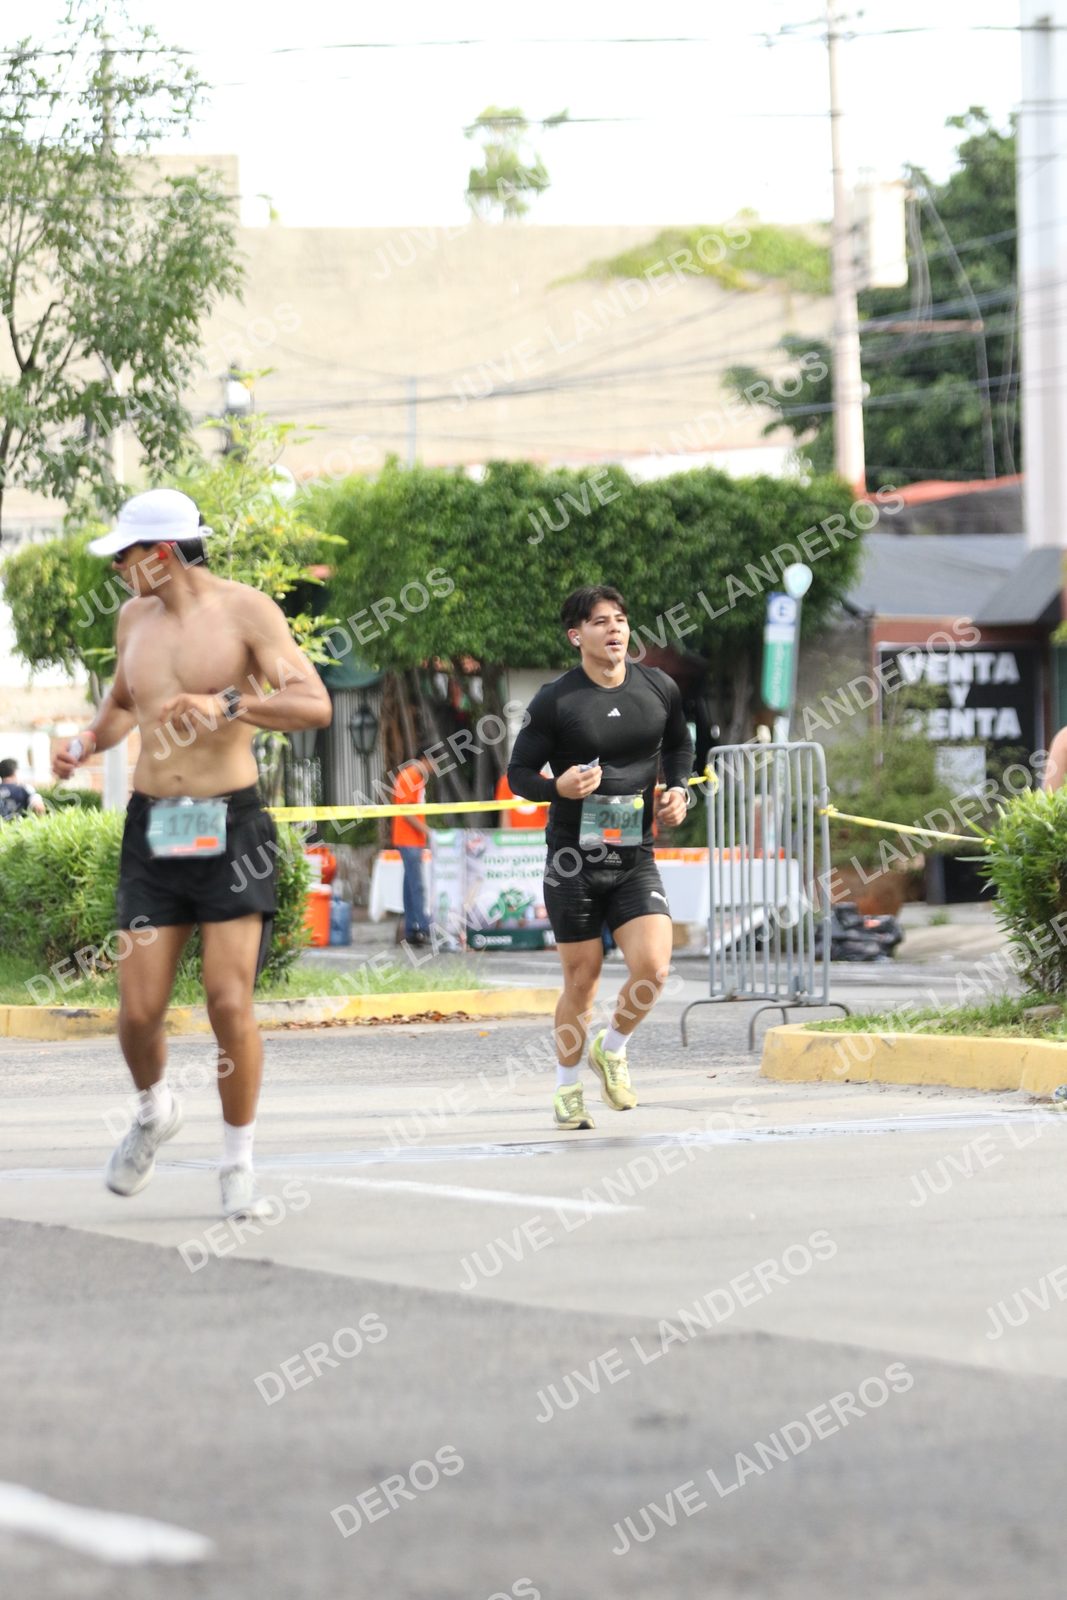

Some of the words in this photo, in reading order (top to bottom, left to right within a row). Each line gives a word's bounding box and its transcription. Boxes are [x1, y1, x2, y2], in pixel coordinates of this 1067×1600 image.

[898, 651, 1021, 684] VENTA
[948, 682, 971, 708] Y
[599, 809, 640, 829] 2091
